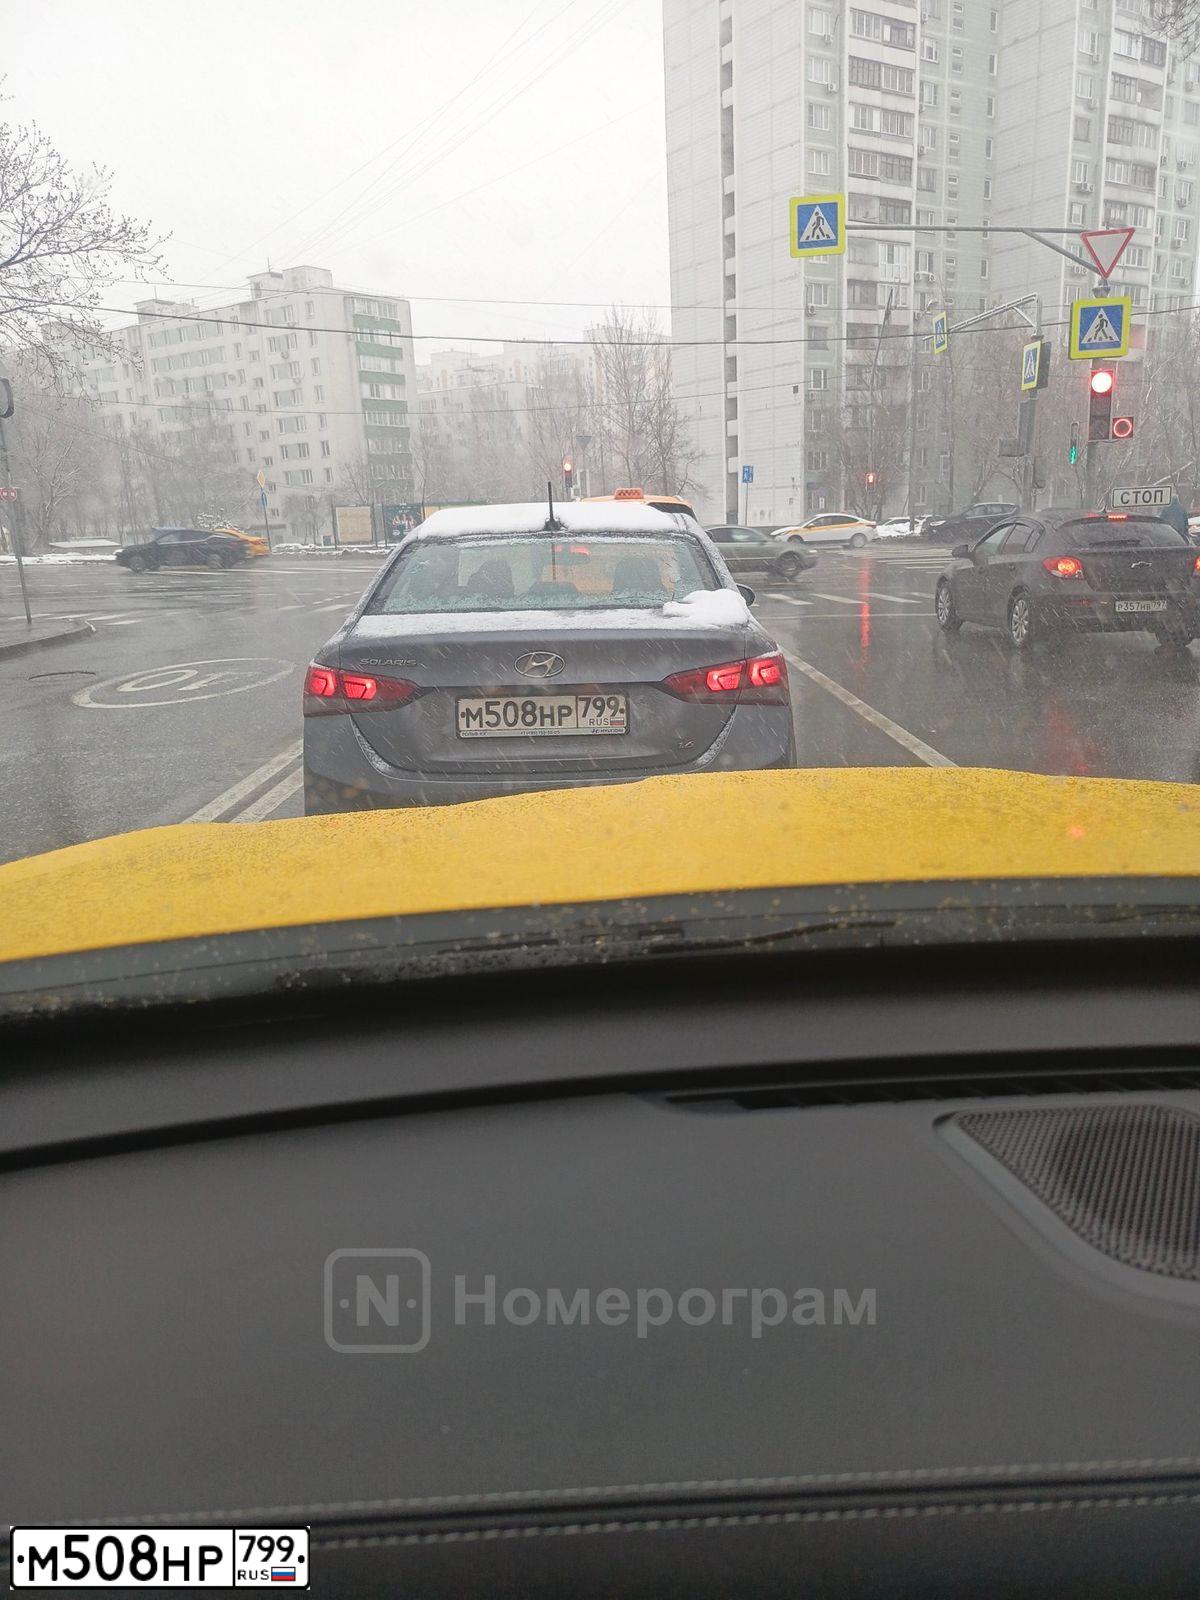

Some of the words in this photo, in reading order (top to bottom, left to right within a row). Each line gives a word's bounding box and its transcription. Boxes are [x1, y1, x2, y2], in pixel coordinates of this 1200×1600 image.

[1120, 489, 1164, 505] СТОП
[359, 657, 418, 667] SOLARIS
[578, 696, 620, 718] 799
[588, 718, 610, 726] RUS
